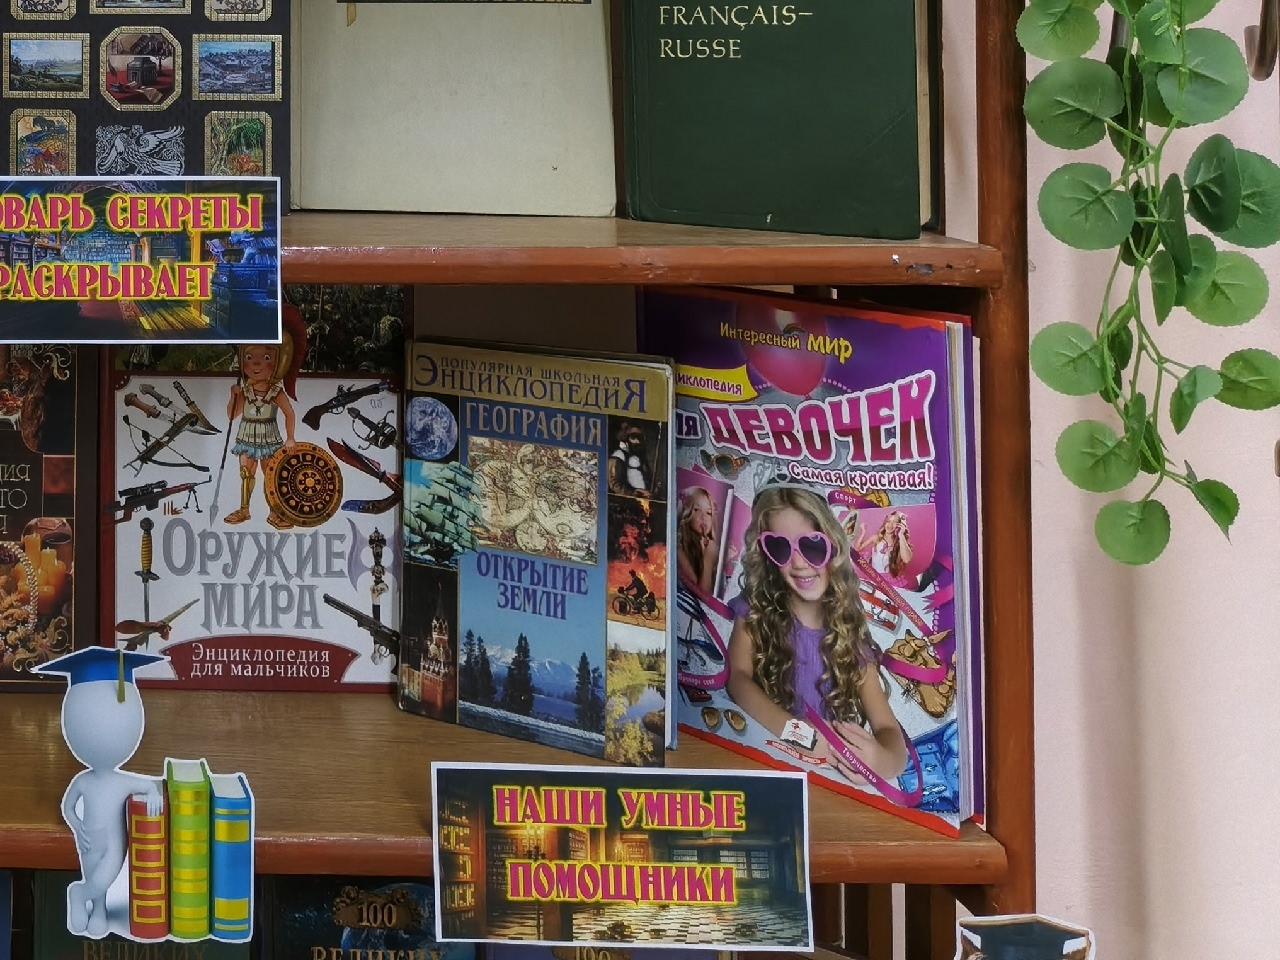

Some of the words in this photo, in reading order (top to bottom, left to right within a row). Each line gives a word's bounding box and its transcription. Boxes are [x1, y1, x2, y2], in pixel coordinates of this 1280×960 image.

[659, 38, 742, 59] RUSSE
[108, 196, 262, 230] СЕКРЕТЫ
[720, 321, 801, 350] Интересный
[414, 354, 648, 414] ЭНЦИКЛОПЕДИЯ
[440, 358, 532, 378] ПОПУЛЯРНАЯ
[541, 365, 620, 387] ШКОЛЬНАЯ
[465, 401, 602, 447] ГЕОГРАФИЯ
[703, 370, 934, 464] ДЕВОЧЕК
[790, 463, 844, 486] Самая
[847, 464, 935, 491] красивая!
[161, 517, 349, 581] ОРУЖИЕ
[476, 551, 590, 596] ОТКРЫТИЕ
[201, 579, 324, 635] МИРА
[497, 583, 568, 621] ЗЕМЛИ
[191, 642, 329, 663] Энциклопедия
[191, 662, 227, 677] для
[230, 662, 330, 679] мальчиков
[841, 747, 878, 783] Творчество
[494, 787, 605, 826] НАШИ
[620, 791, 744, 830] УМНЫЕ
[508, 862, 736, 906] ПОМОЩНИКИ
[357, 903, 398, 928] 100
